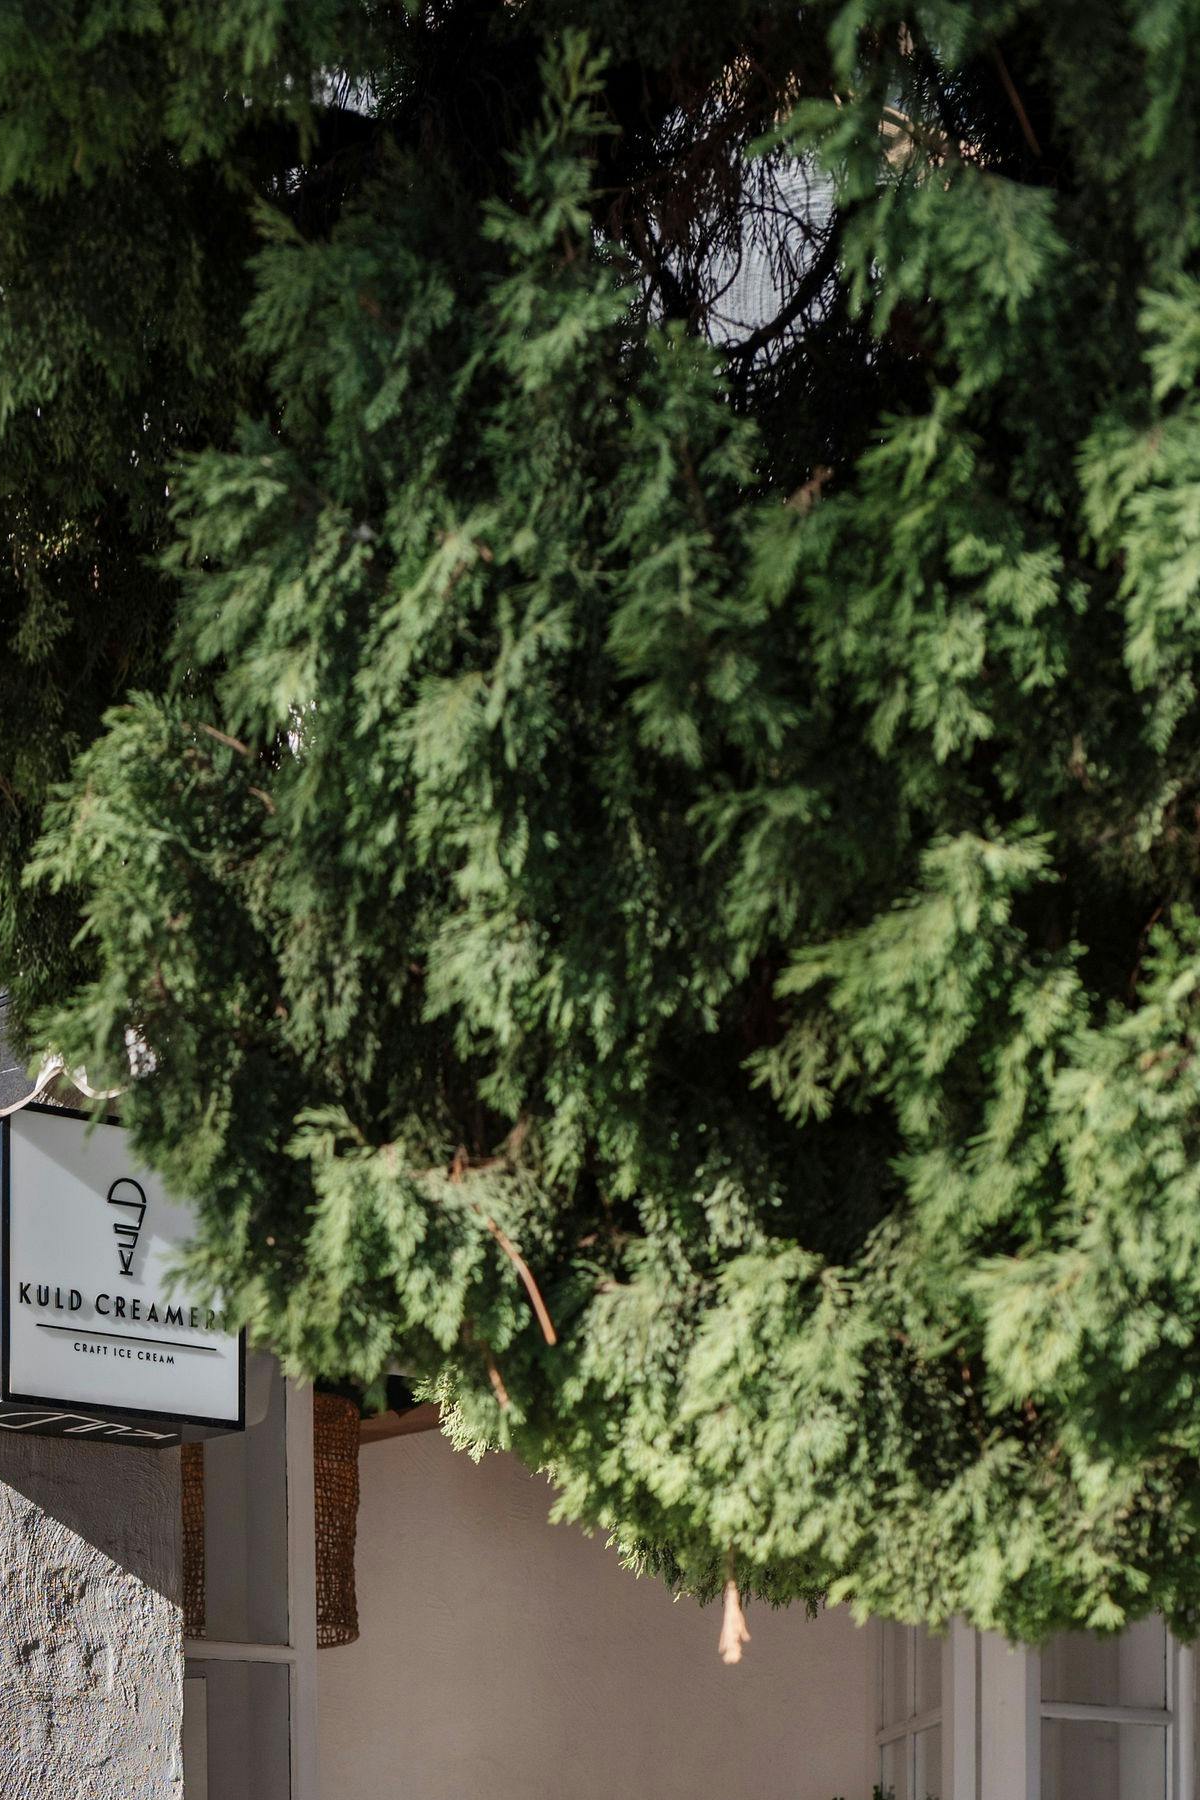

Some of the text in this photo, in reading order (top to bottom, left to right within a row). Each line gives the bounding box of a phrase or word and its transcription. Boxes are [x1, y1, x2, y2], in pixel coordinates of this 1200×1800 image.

[19, 1282, 82, 1311] KULD
[74, 1342, 175, 1364] CRAFT ICE CREAM
